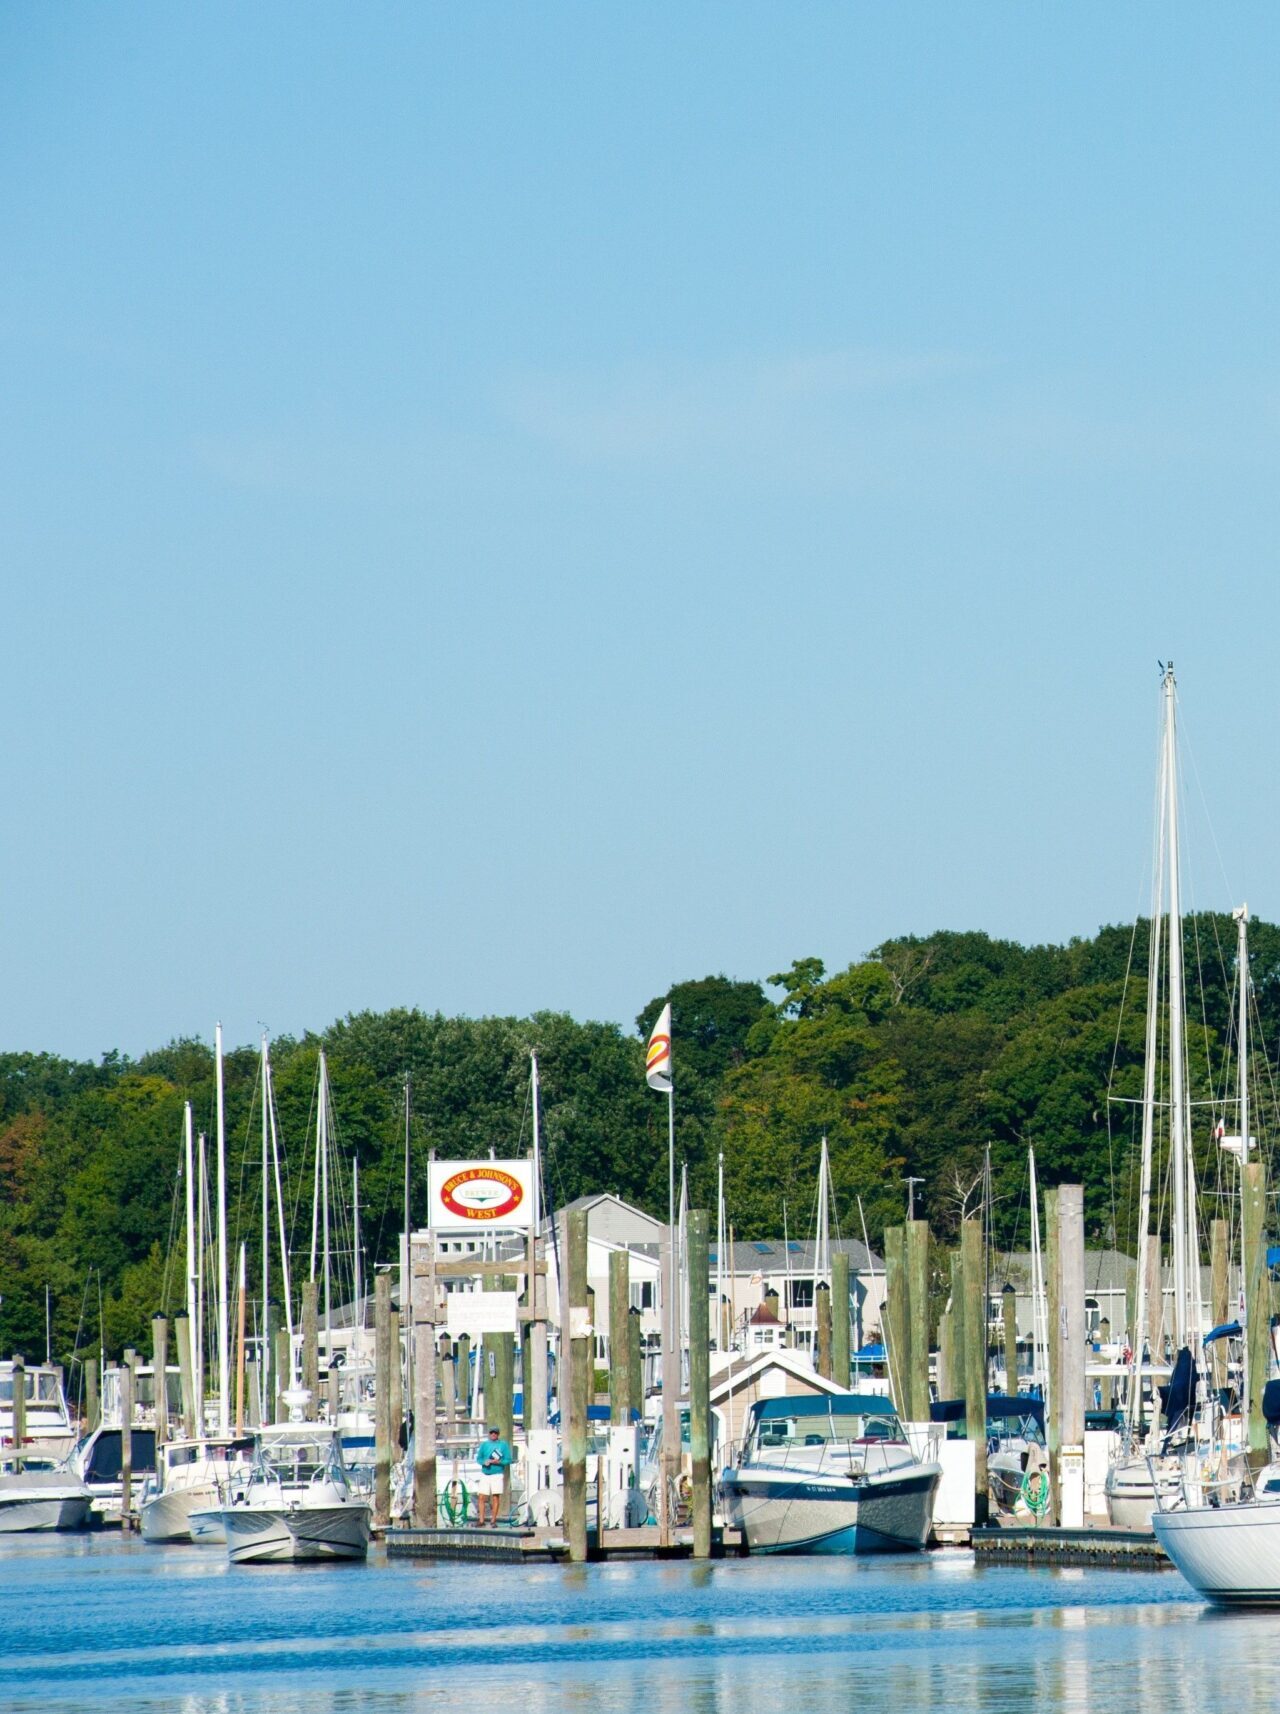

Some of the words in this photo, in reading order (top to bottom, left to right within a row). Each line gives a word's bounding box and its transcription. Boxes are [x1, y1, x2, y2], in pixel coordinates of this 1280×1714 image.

[444, 1172, 468, 1192] BRUCE
[469, 1171, 475, 1179] &
[477, 1169, 517, 1190] JOHNSON'S
[466, 1209, 497, 1218] WEST
